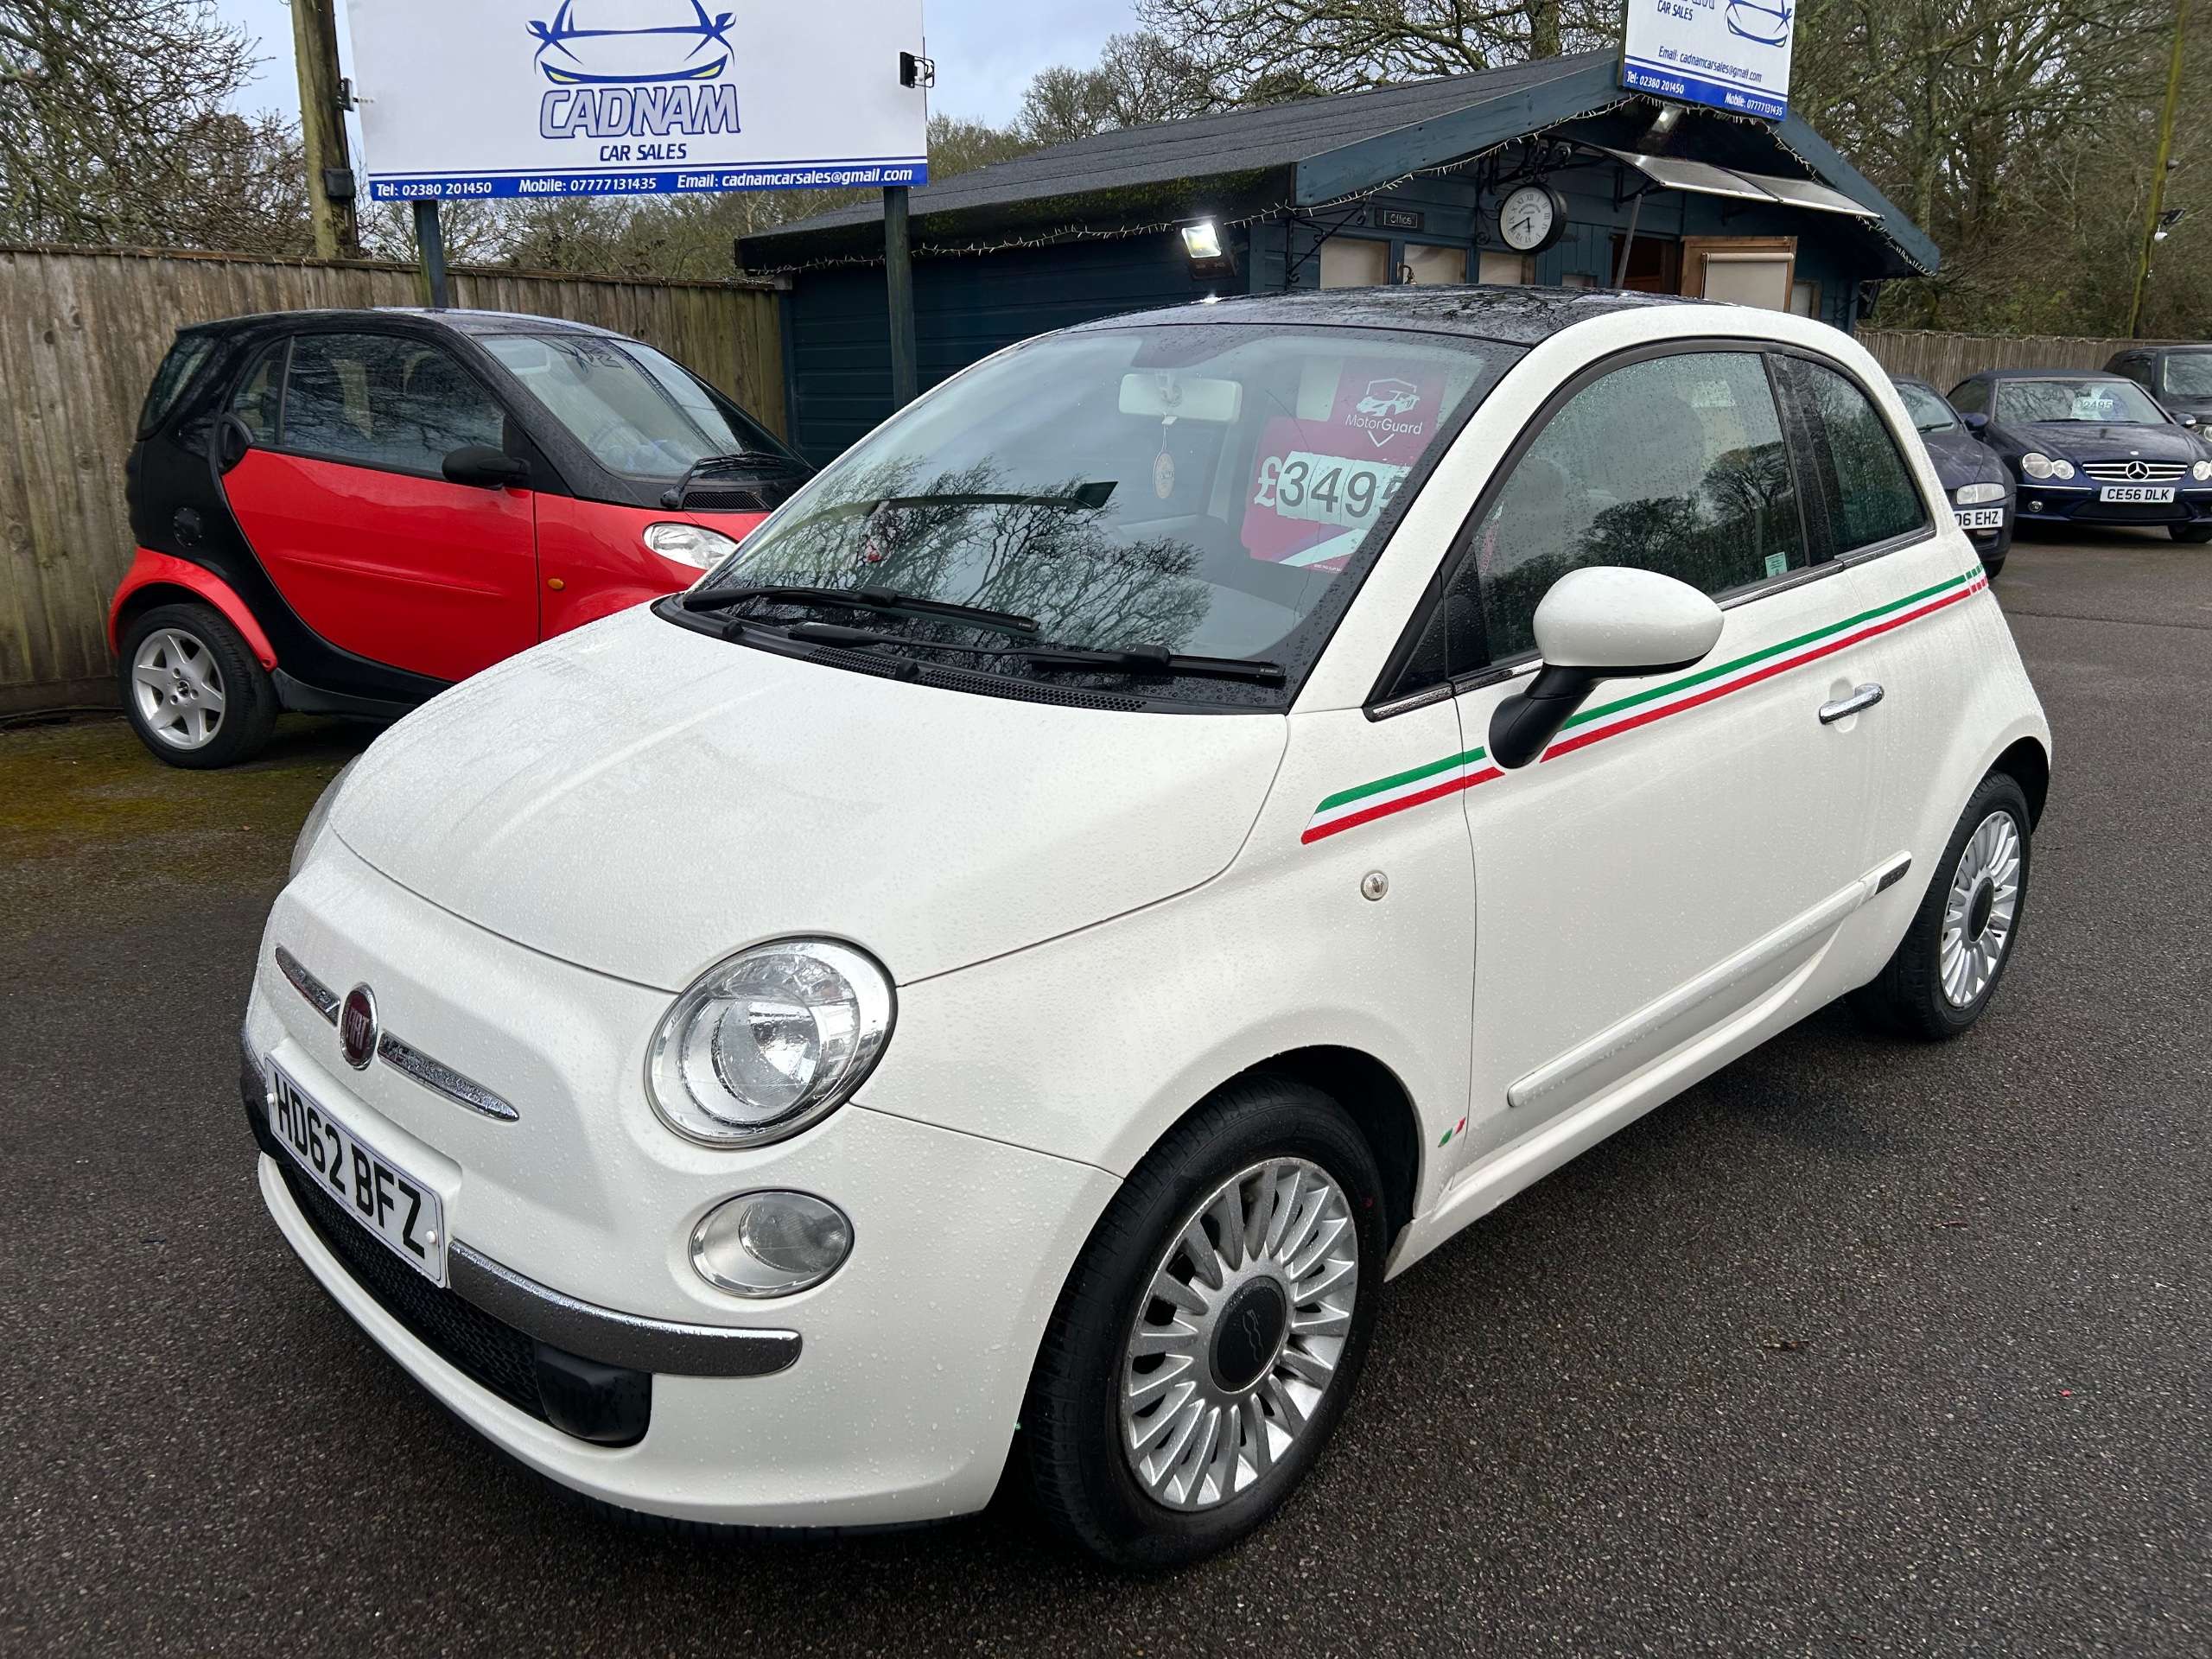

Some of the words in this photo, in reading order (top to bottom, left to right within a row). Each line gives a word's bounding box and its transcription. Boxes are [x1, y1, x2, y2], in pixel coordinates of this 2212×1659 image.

[1656, 0, 1671, 14] CAR
[1672, 4, 1694, 21] SALES
[1658, 46, 1679, 62] Email:
[1626, 71, 1638, 85] Tel:
[1639, 76, 1660, 89] 02380
[1661, 79, 1684, 94] 201450
[1725, 92, 1746, 108] Mobile:
[540, 84, 741, 139] CADNAM
[600, 144, 631, 162] CAR
[636, 143, 687, 161] SALES
[376, 183, 399, 197] Tel:
[402, 183, 442, 196] 02380
[446, 181, 492, 195] 201450
[518, 178, 567, 193] Mobile:
[570, 177, 657, 192] 07777131435
[677, 173, 719, 188] Email:
[721, 168, 912, 187] cadnamcarsales@gmail.com
[1390, 213, 1412, 225] Office
[1344, 413, 1424, 435] MotorGuard
[2107, 488, 2142, 500] CE56
[2144, 489, 2170, 500] DLK
[1975, 511, 1999, 525] EHZ
[274, 1071, 346, 1195] HD62
[351, 1142, 425, 1260] BFZ
